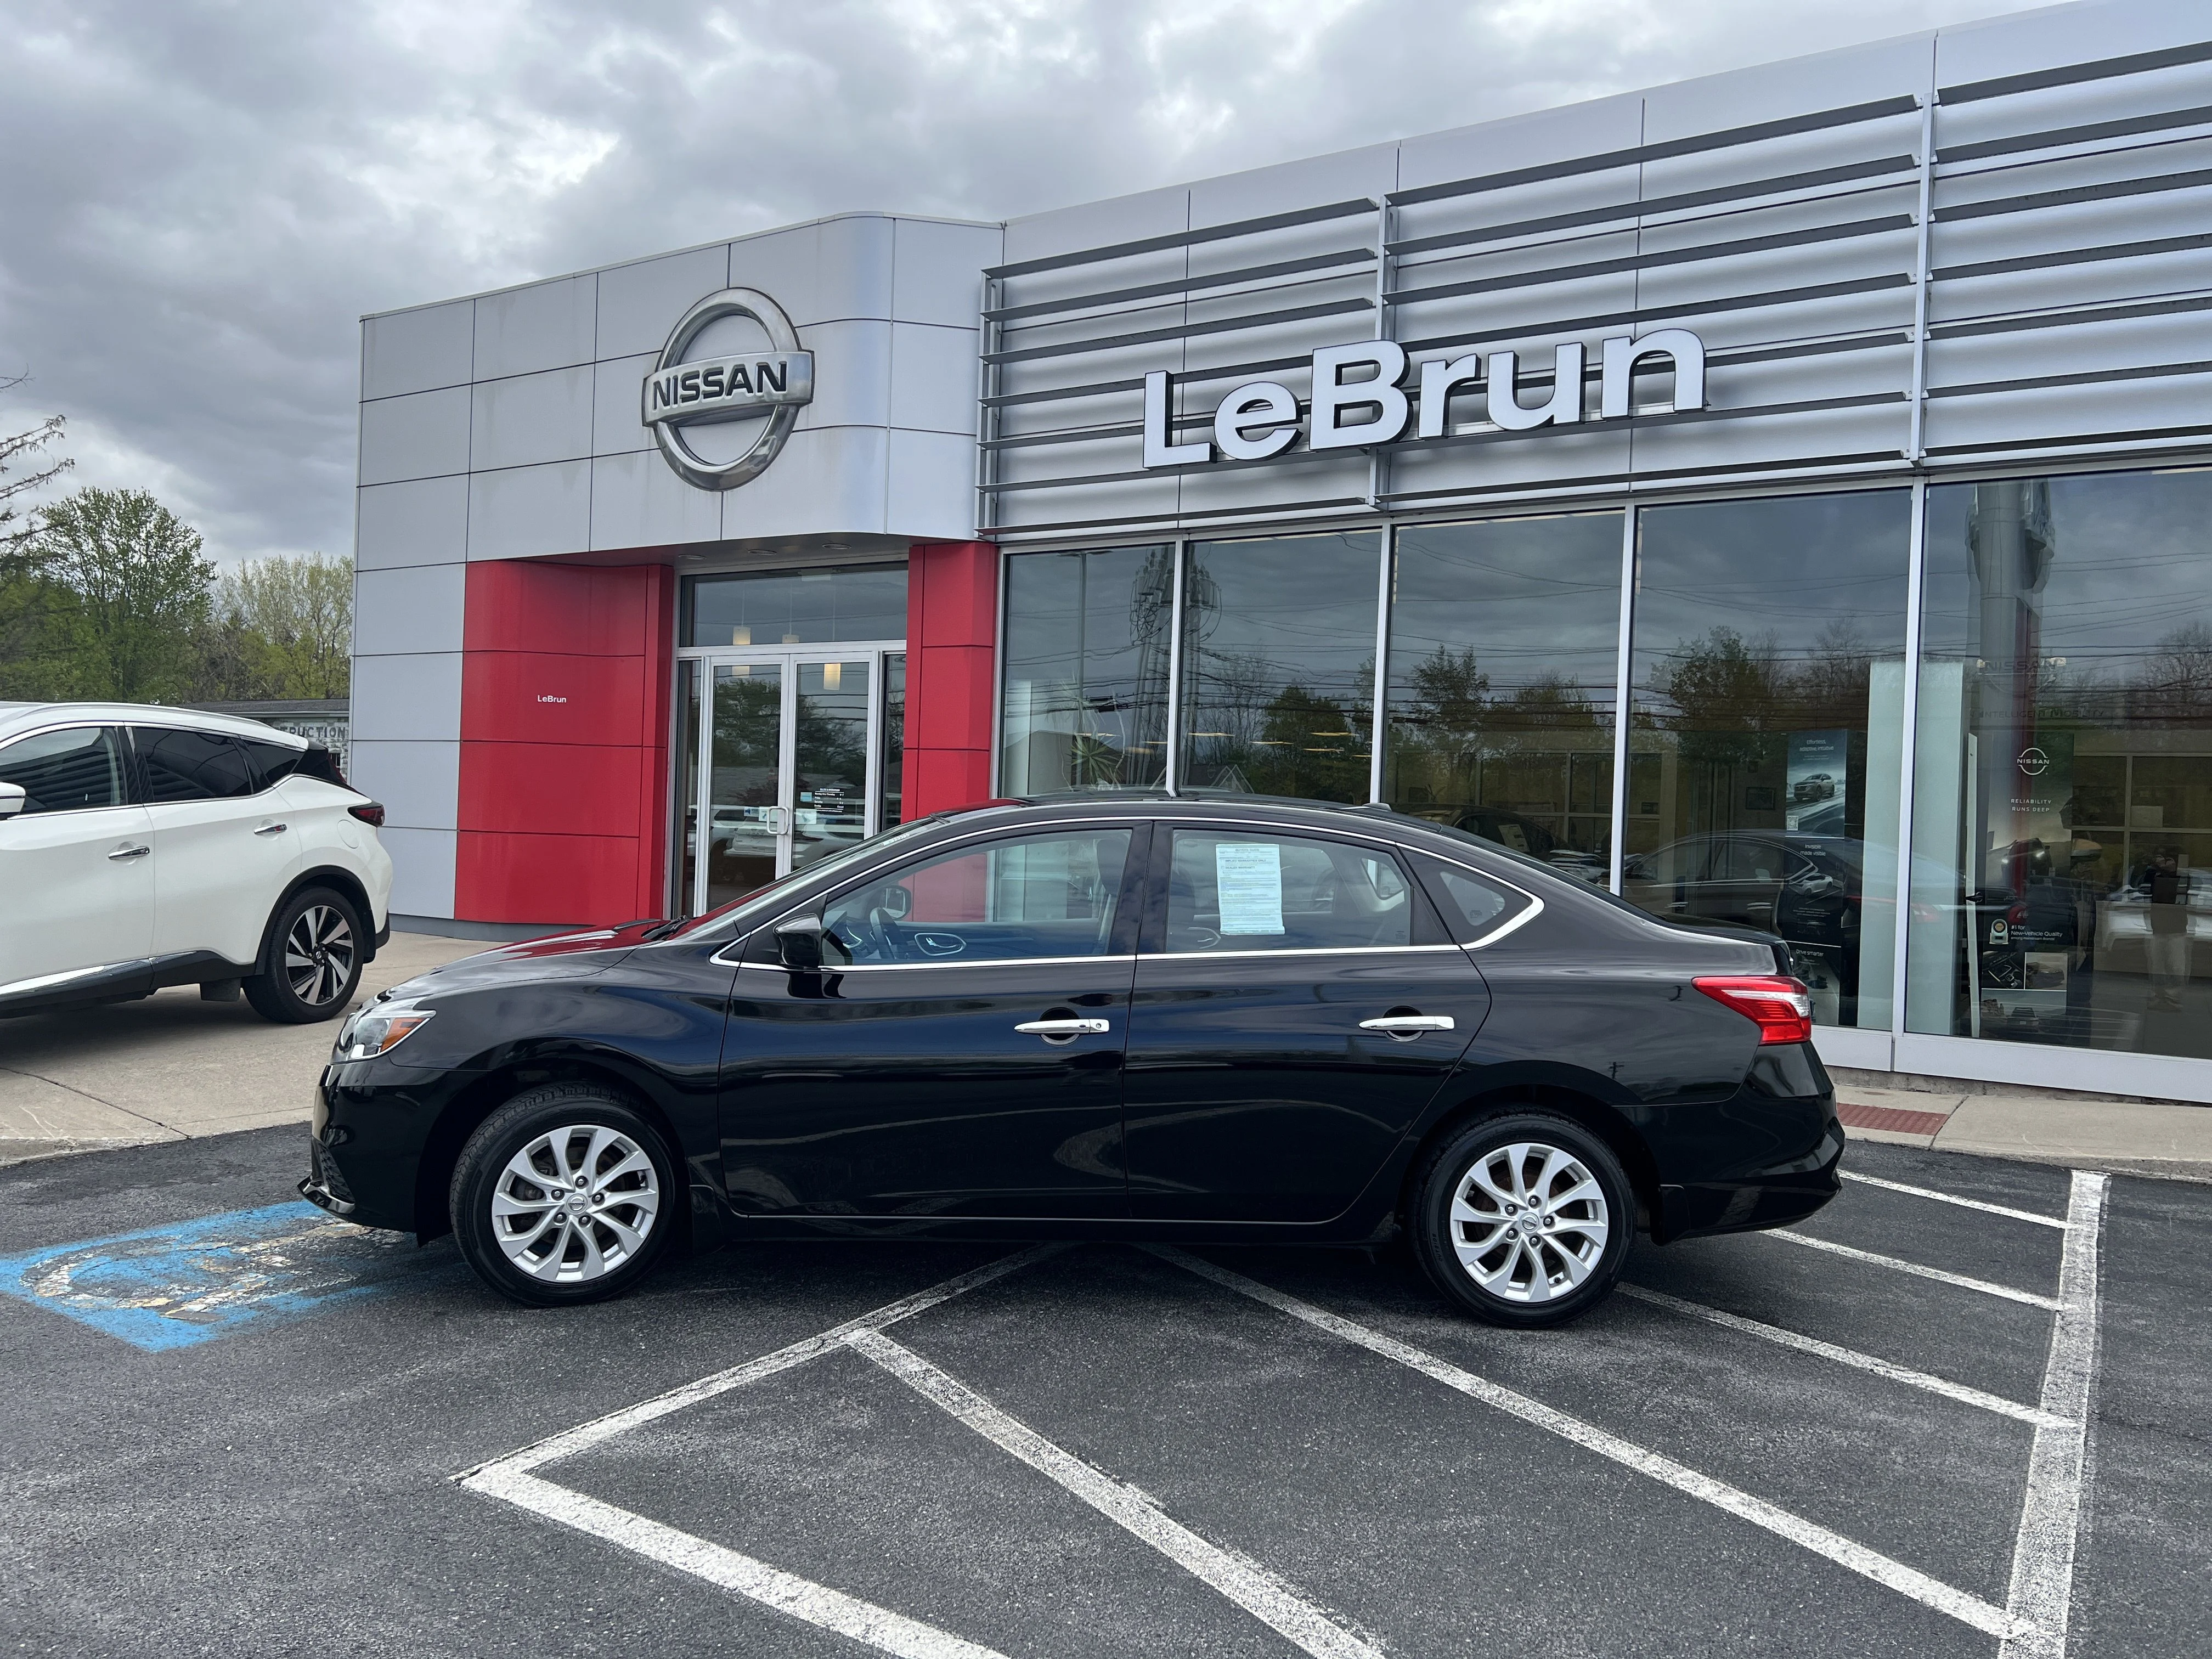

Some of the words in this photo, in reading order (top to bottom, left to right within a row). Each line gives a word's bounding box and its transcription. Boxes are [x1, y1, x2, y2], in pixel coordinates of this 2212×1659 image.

[653, 360, 787, 410] NISSAN
[1143, 328, 1707, 470] LeBrun
[538, 695, 567, 703] LeBrun
